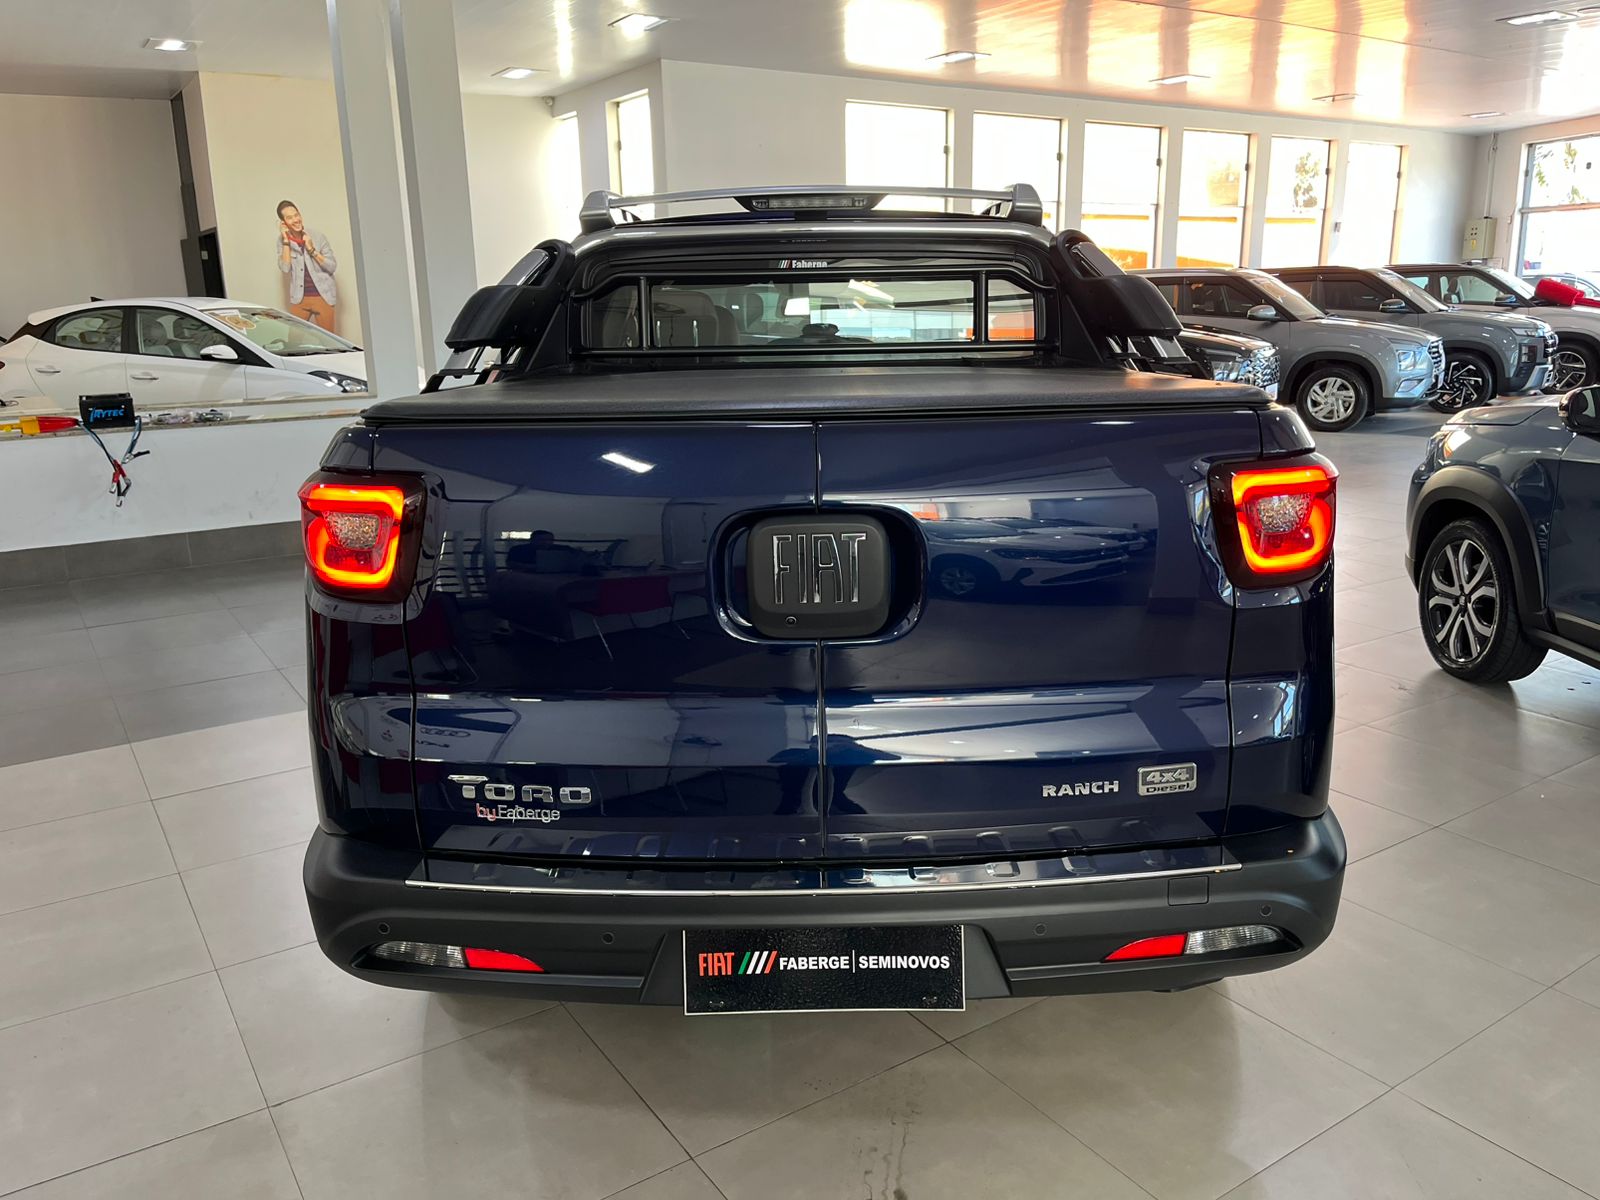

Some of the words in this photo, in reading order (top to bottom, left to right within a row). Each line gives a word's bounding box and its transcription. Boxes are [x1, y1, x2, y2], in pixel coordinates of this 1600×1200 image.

[772, 533, 867, 604] FIAT
[1146, 768, 1190, 784] 4x4
[448, 774, 592, 804] TORO
[1042, 780, 1120, 798] RANCH
[1145, 783, 1190, 794] Diesel
[698, 952, 736, 977] FIAT
[779, 956, 850, 970] FABERGE
[858, 955, 951, 970] SEMINOVOS
